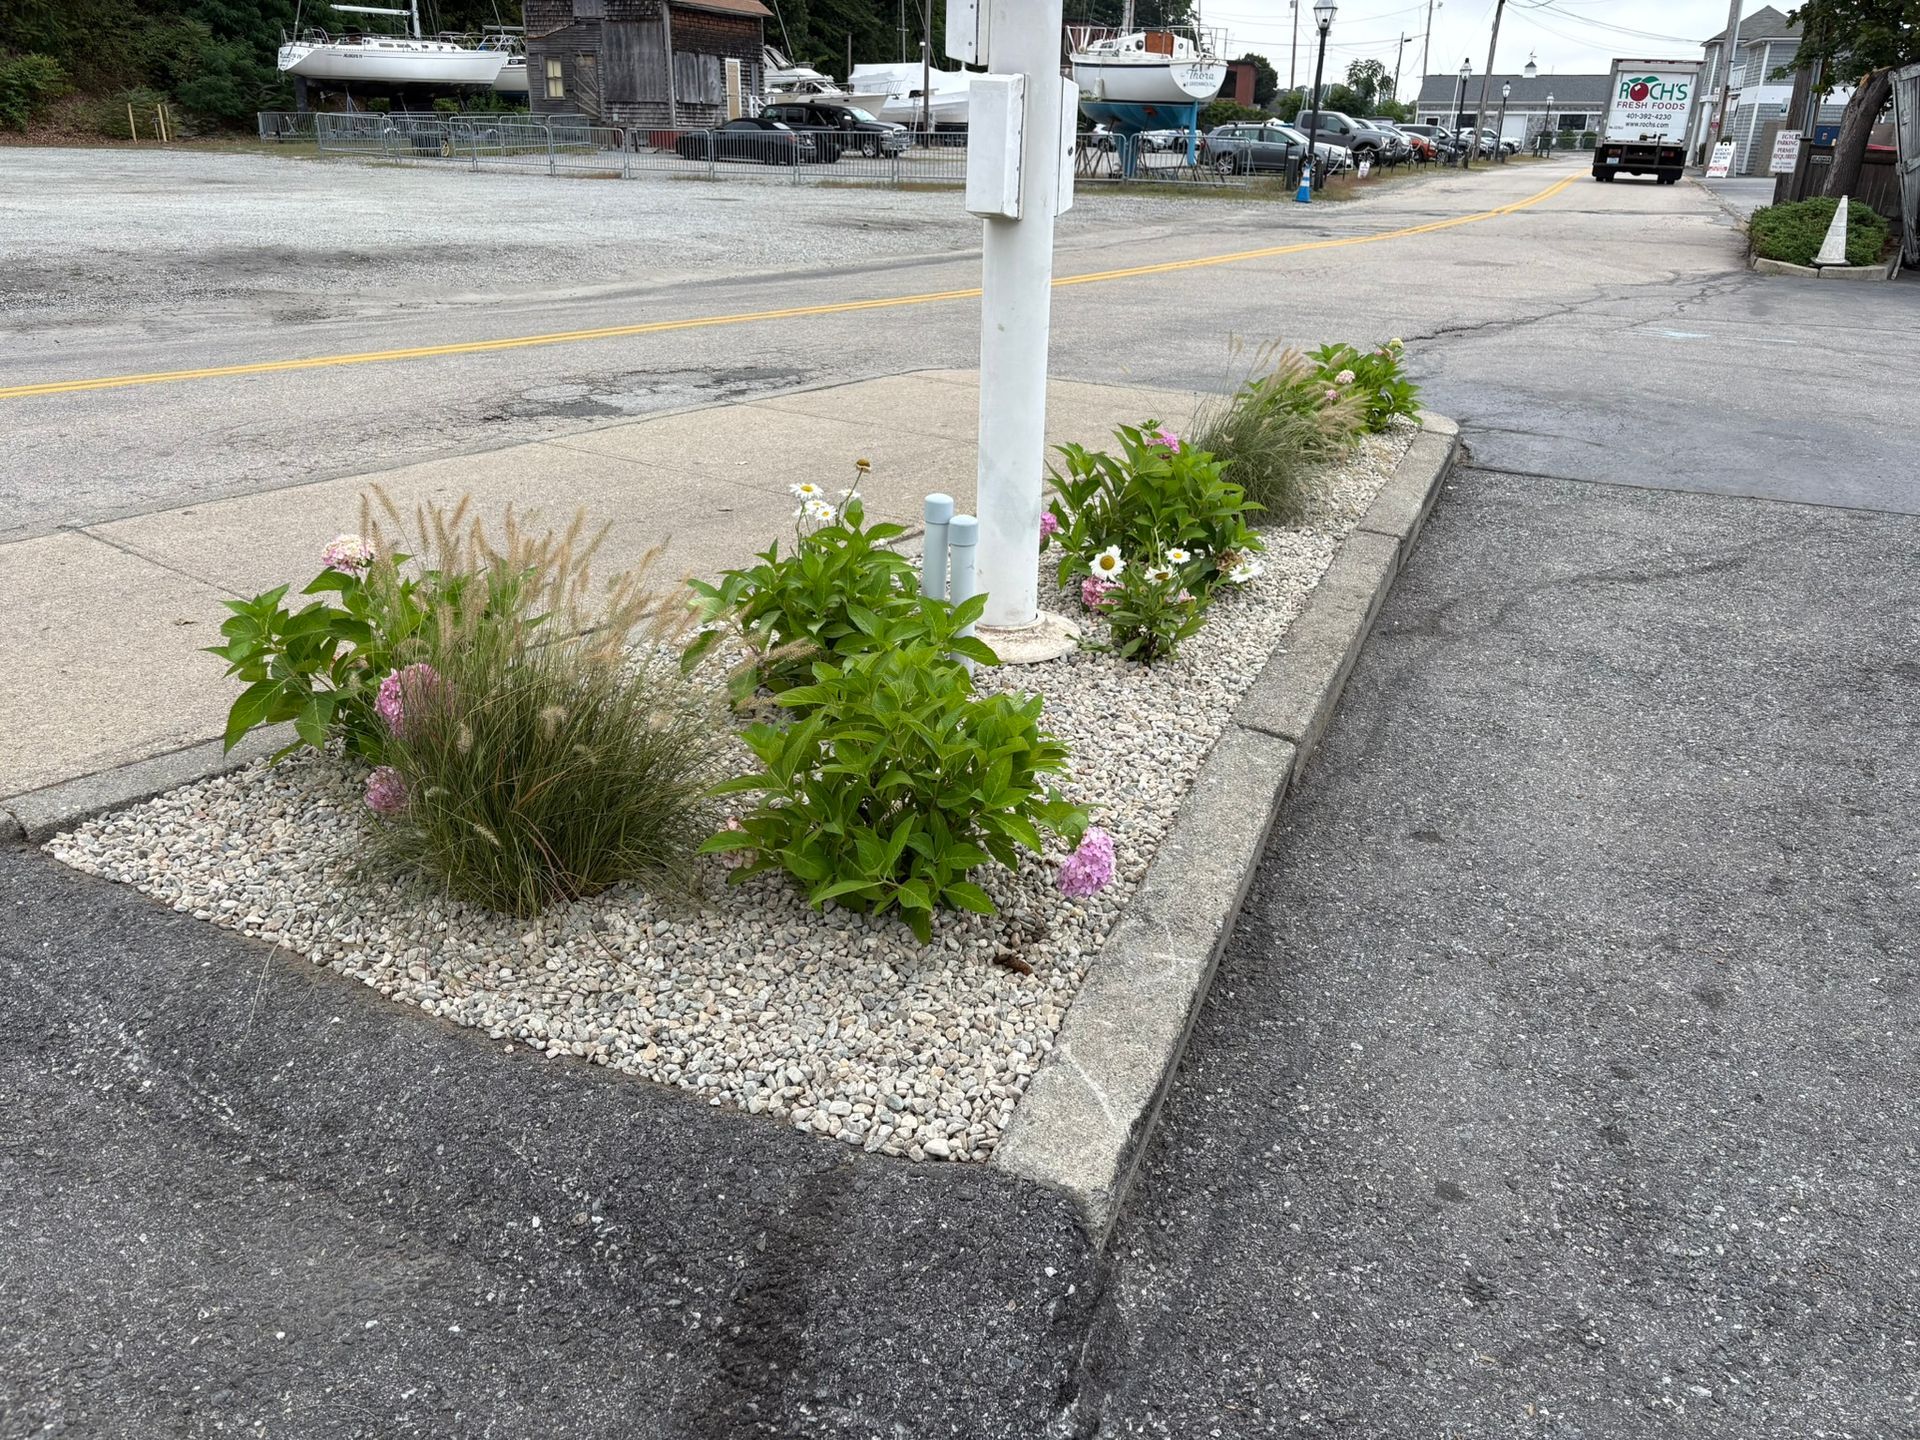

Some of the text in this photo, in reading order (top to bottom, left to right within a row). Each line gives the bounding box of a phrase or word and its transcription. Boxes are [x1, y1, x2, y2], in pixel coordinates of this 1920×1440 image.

[1186, 69, 1214, 80] Thora
[1618, 82, 1688, 101] ROCH'S
[1616, 101, 1686, 111] FRESH FOODS
[1626, 113, 1672, 121] 401-392-4230
[1625, 121, 1670, 129] www.rochs.com
